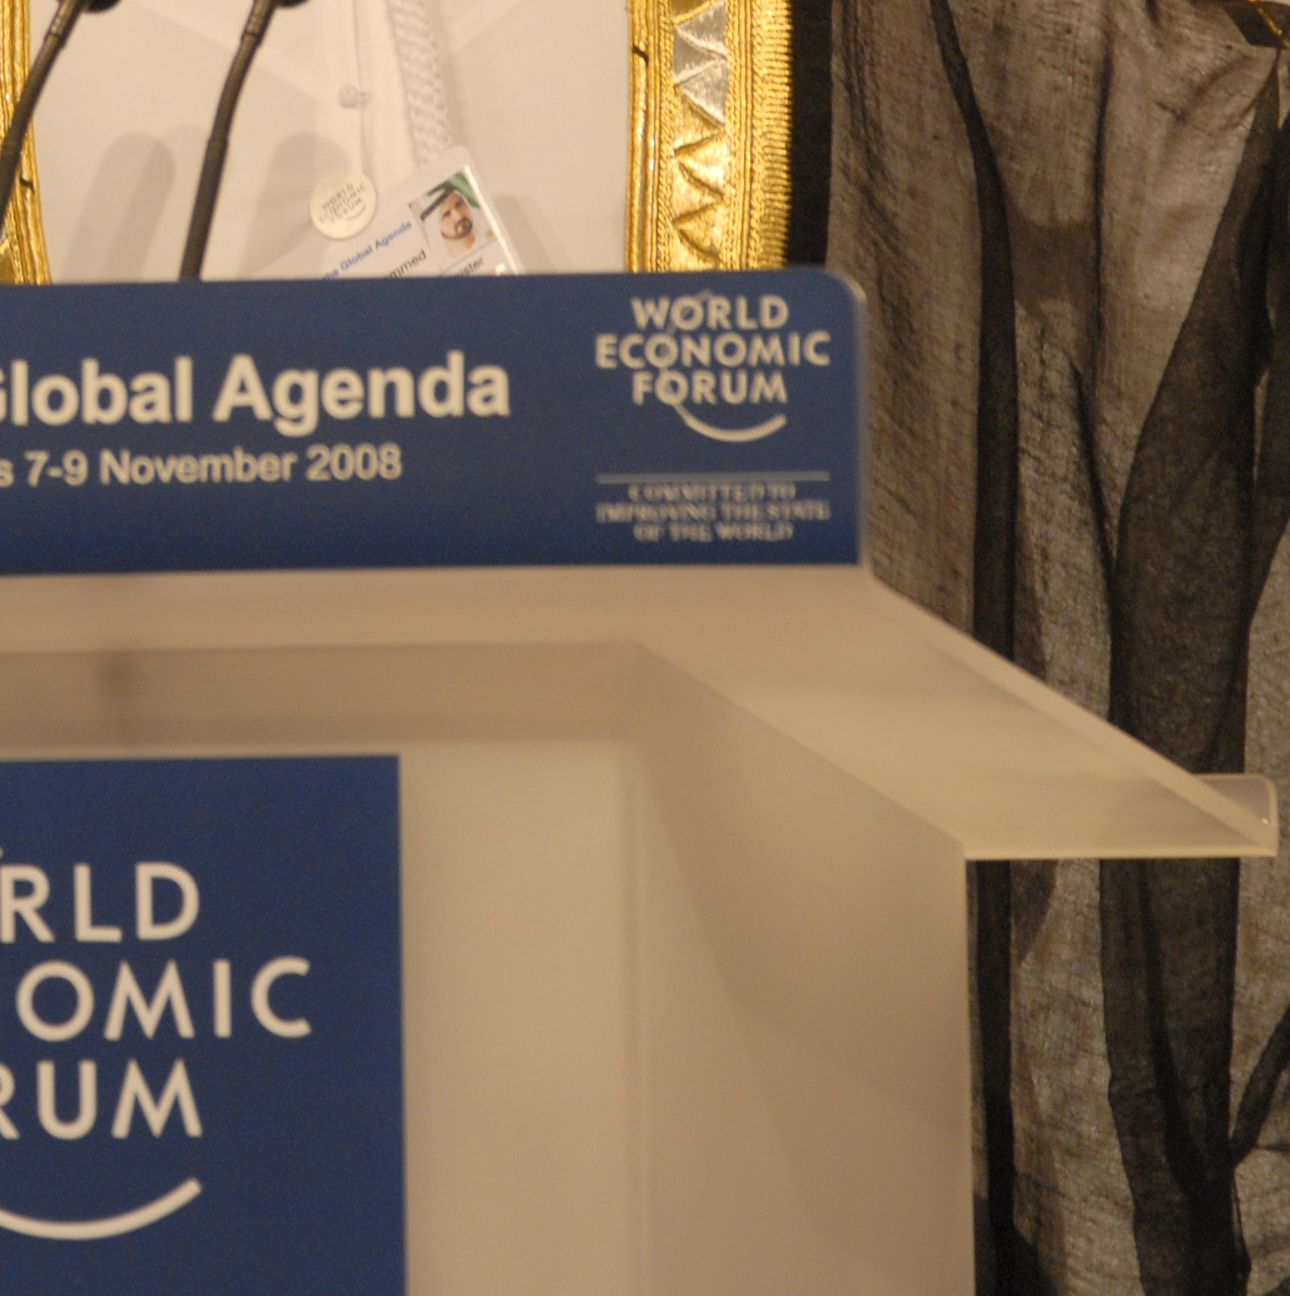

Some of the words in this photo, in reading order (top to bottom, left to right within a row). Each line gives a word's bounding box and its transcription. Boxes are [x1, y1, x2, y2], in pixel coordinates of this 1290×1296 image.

[339, 245, 373, 271] Global
[375, 221, 412, 249] Agenda
[631, 295, 789, 331] WORLD
[596, 330, 832, 369] ECONOMIC
[212, 351, 510, 436] Agenda
[632, 369, 787, 405] FORUM
[25, 450, 89, 487] 7-9
[100, 446, 297, 486] November
[306, 443, 403, 481] 2008
